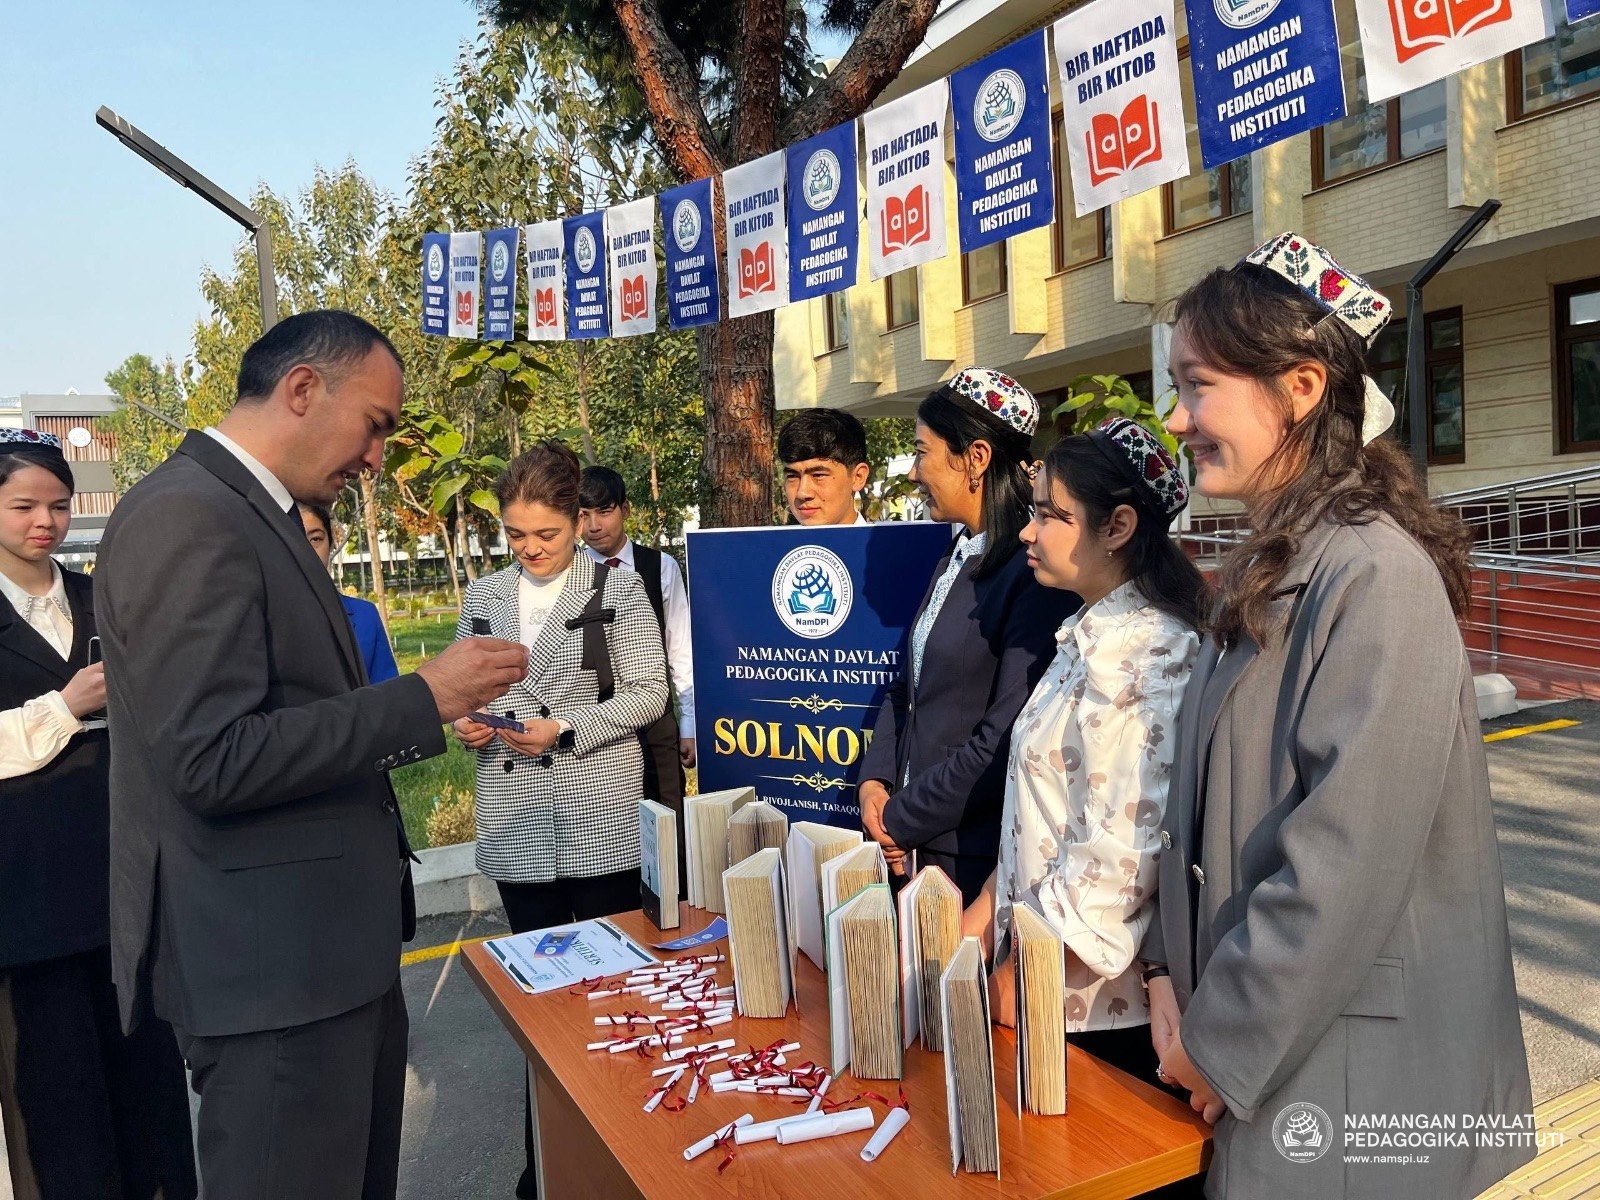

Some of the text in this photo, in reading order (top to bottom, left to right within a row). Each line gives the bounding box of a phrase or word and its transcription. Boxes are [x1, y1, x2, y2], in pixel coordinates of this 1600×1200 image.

[1238, 3, 1269, 22] NamDPI
[1065, 15, 1166, 81] BIR HAFTADA
[1216, 15, 1302, 71] NAMANGAN
[1077, 51, 1156, 105] BIR KITOB
[1232, 48, 1289, 90] DAVLAT
[1217, 65, 1316, 122] PEDAGOGIKA
[1229, 95, 1306, 142] INSTITUTI
[871, 121, 938, 166] BIR HAFTADA
[974, 137, 1032, 174] NAMANGAN
[878, 149, 930, 187] BIR KITOB
[985, 162, 1023, 191] DAVLAT
[728, 187, 780, 219] BIR HAFTADA
[972, 178, 1038, 216] PEDAGOGIKA
[734, 211, 774, 238] BIR KITOB
[802, 210, 845, 236] NAMANGAN
[979, 202, 1031, 234] INSTITUTI
[613, 229, 651, 251] BIR HAFTADA
[810, 231, 837, 251] DAVLAT
[536, 247, 559, 261] HAFTADA
[617, 249, 647, 268] BIR KITOB
[674, 254, 705, 273] NAMANGAN
[800, 246, 848, 272] PEDAGOGIKA
[540, 265, 556, 277] KITOB
[680, 272, 701, 287] DAVLAT
[806, 266, 843, 288] INSTITUTI
[675, 286, 711, 304] PEDAGOGIKA
[680, 304, 708, 319] INSTITUTI
[805, 550, 840, 571] PEDAGOGIKA
[795, 617, 829, 626] NamDPI
[737, 646, 900, 665] NAMANGAN DAVLAT
[726, 665, 829, 683] PEDAGOGIKA
